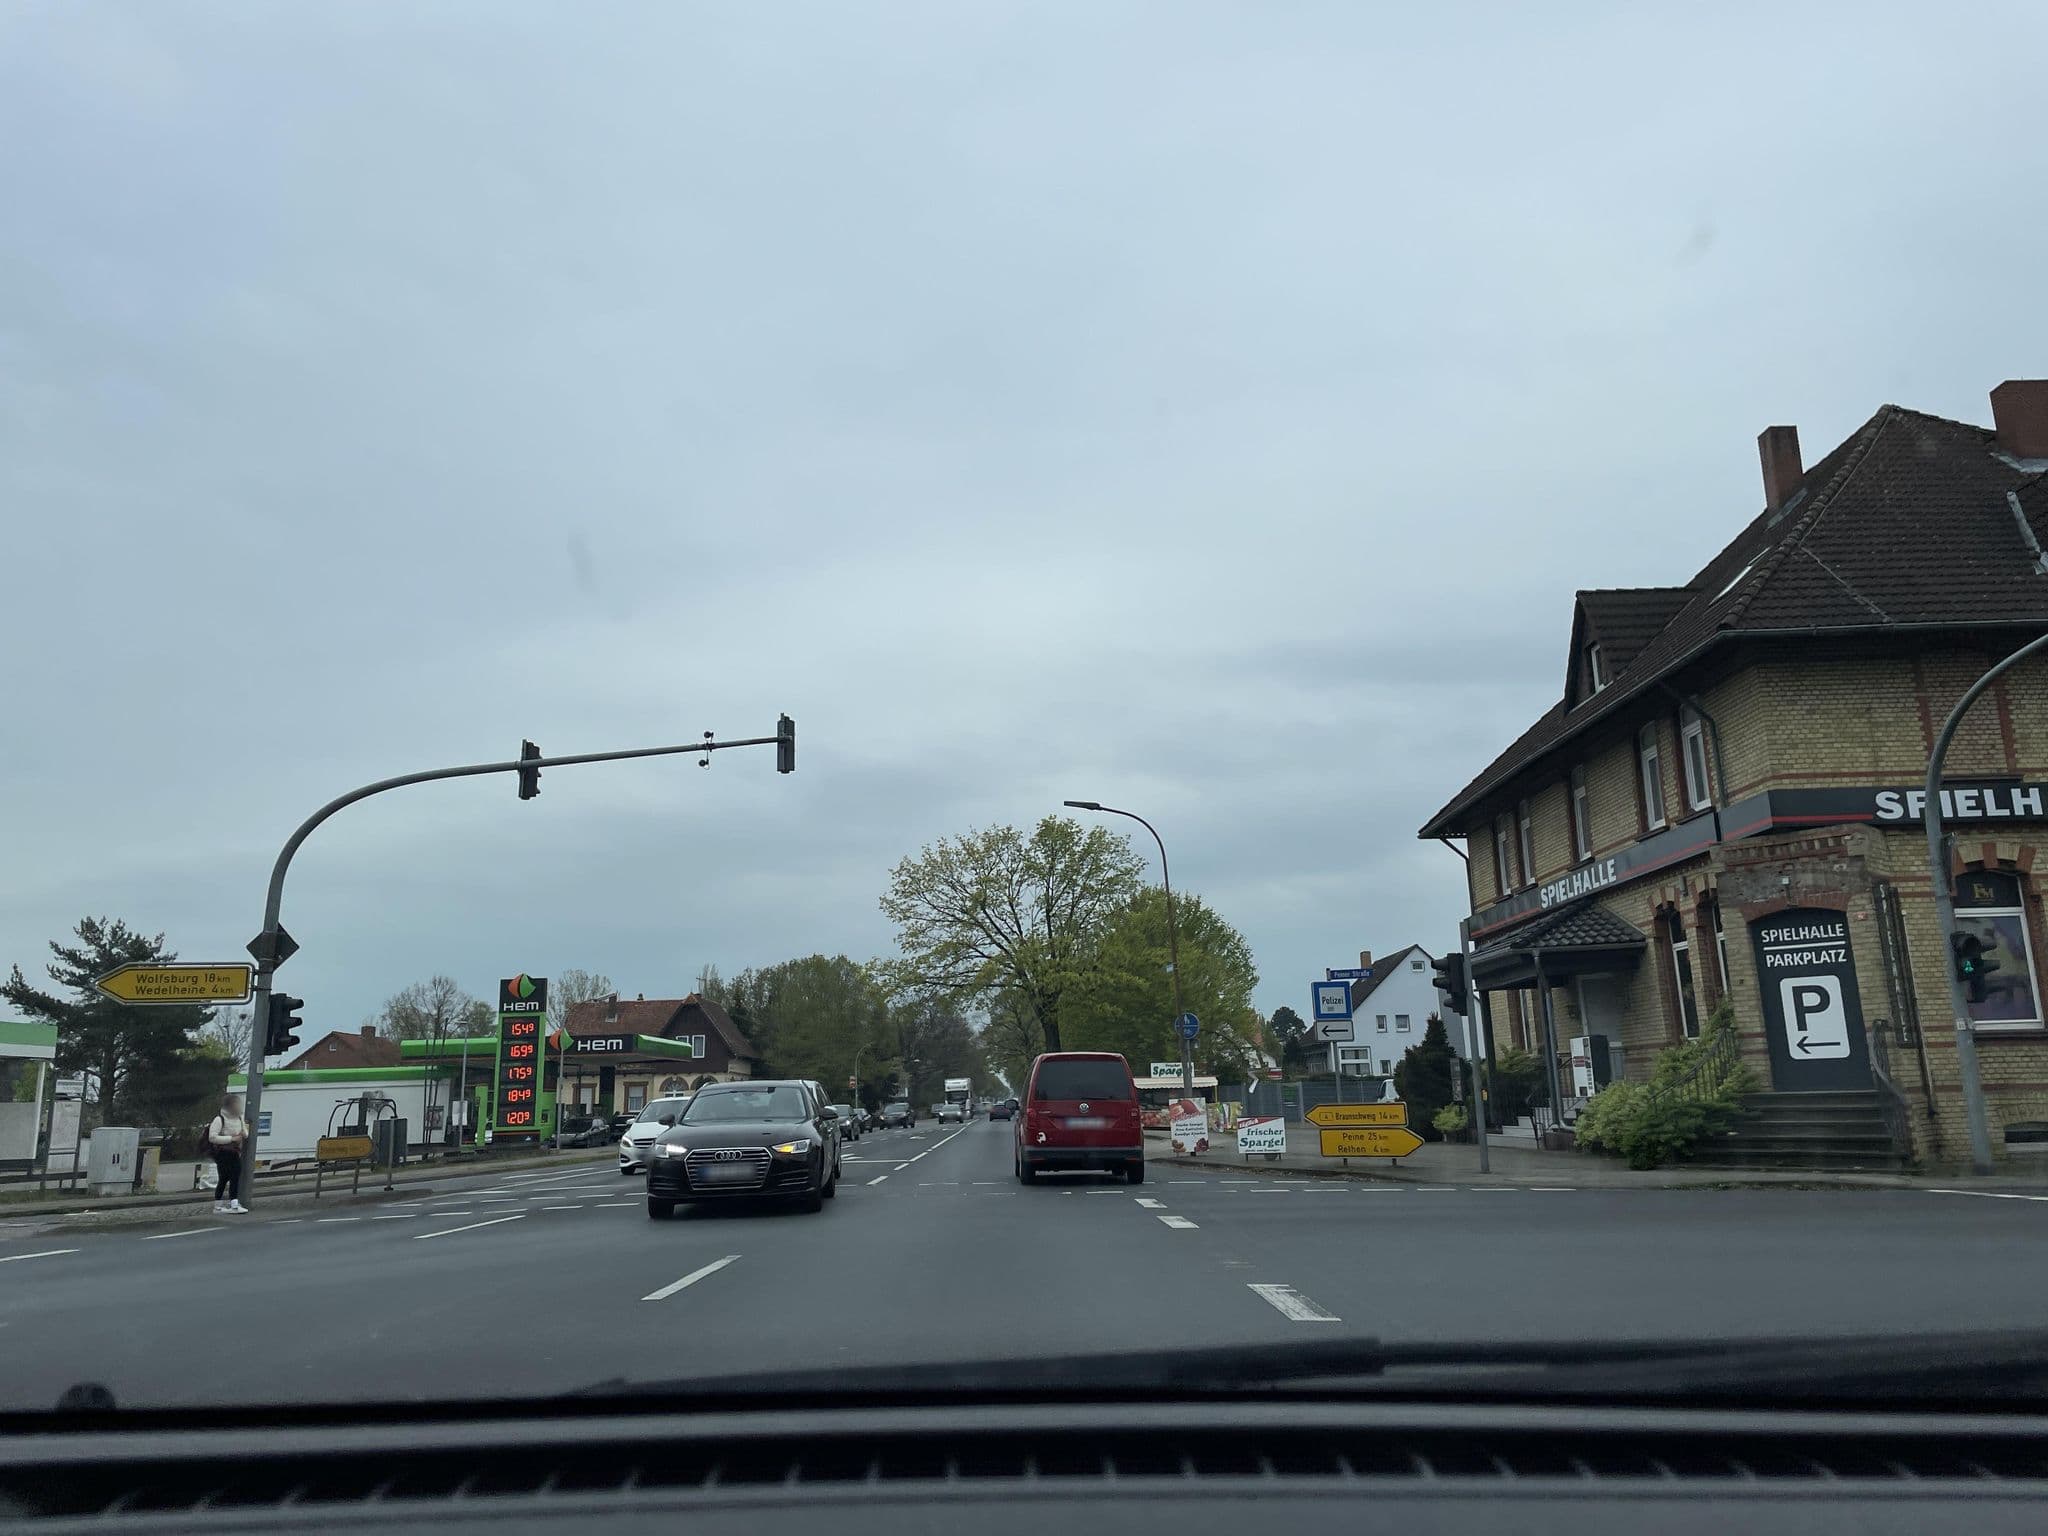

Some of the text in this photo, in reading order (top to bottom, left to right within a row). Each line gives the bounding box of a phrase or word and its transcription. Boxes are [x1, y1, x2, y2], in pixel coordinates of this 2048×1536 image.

[1540, 858, 1617, 909] SPIELHALLE
[1761, 922, 1846, 943] SPIELHALLE
[1766, 950, 1847, 968] PARKPLATZ
[136, 973, 231, 984] Wolfsburg 18 km
[135, 985, 206, 995] Wedelheine
[211, 985, 219, 994] 4
[1321, 996, 1344, 1005] Polizei
[1793, 985, 1831, 1032] P
[1152, 1065, 1184, 1077] Sparg
[1335, 1112, 1377, 1122] Braunschweig
[1379, 1111, 1388, 1120] 14
[1389, 1112, 1400, 1120] km
[1246, 1127, 1284, 1136] frischer
[1342, 1132, 1365, 1141] Peine
[1367, 1132, 1378, 1141] 25
[1239, 1136, 1285, 1149] Spargel
[1337, 1144, 1367, 1153] Rethen
[1373, 1144, 1380, 1153] 4
